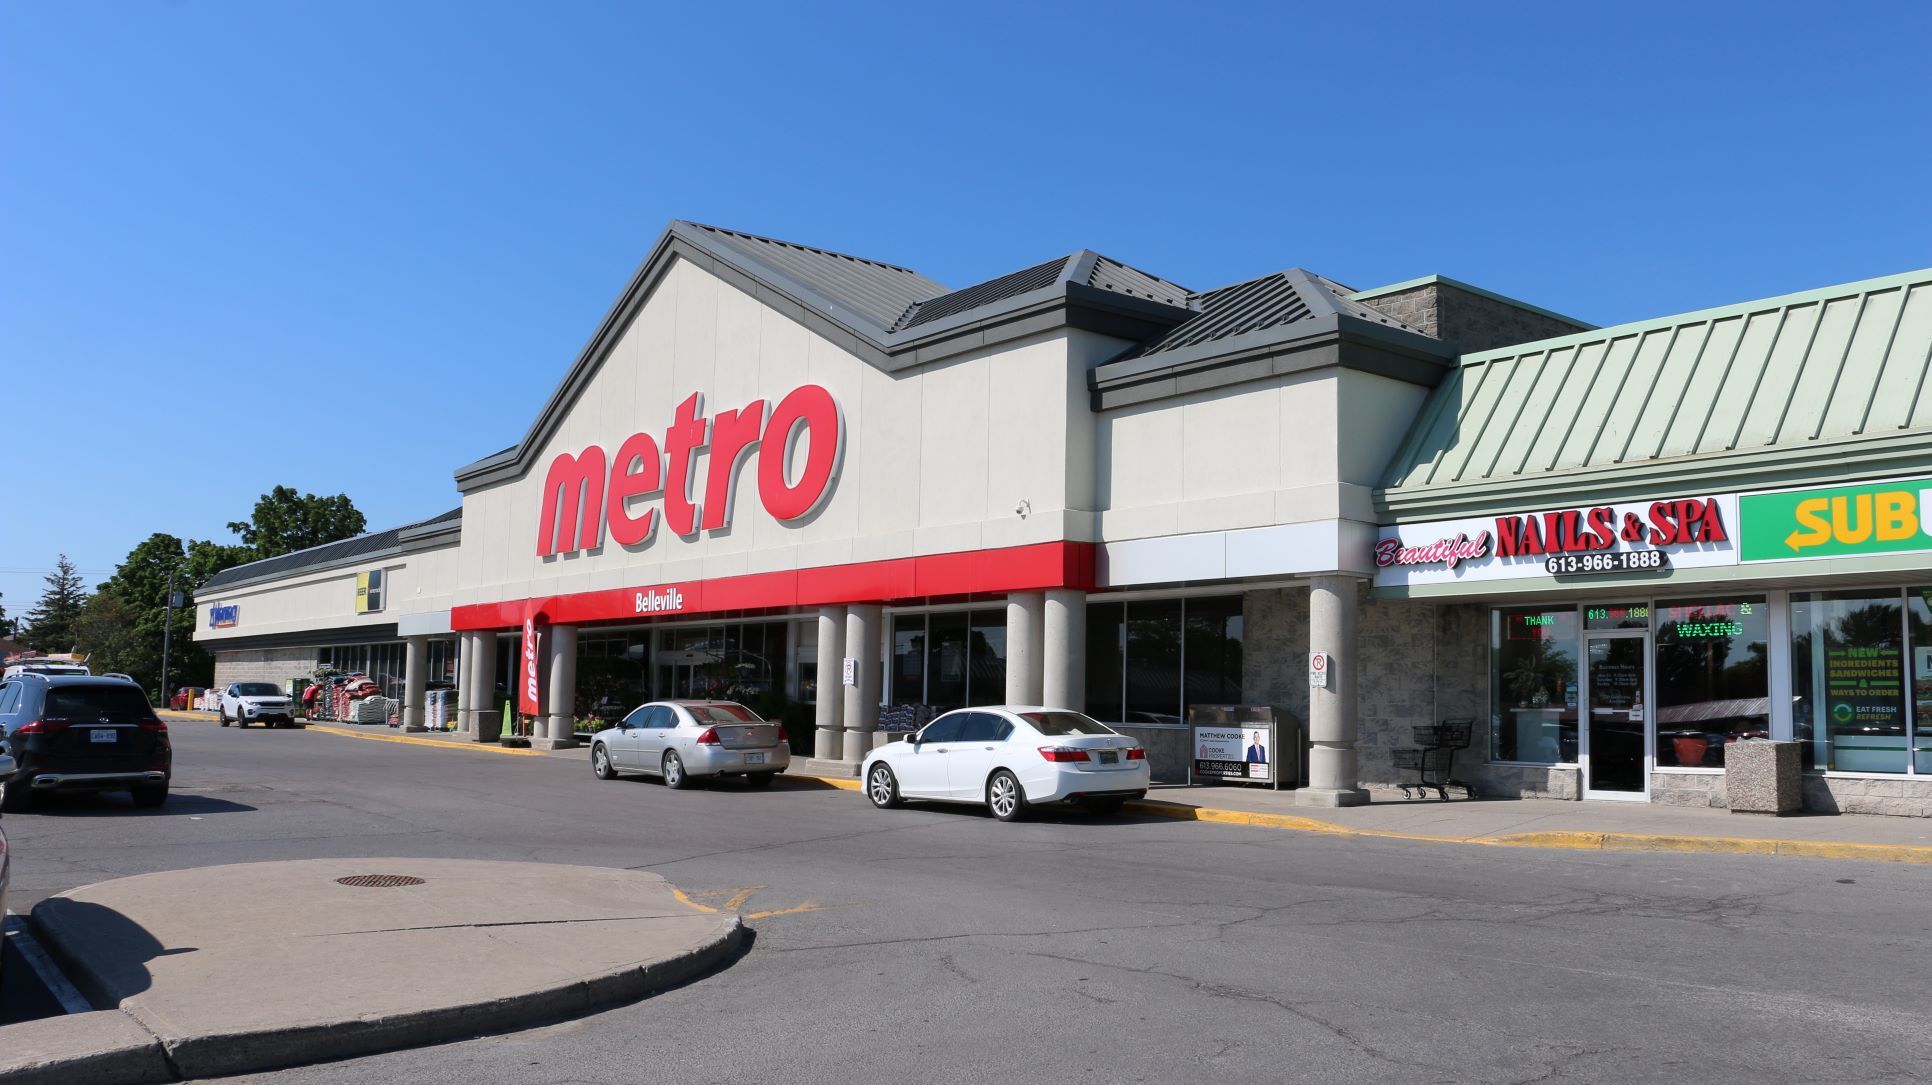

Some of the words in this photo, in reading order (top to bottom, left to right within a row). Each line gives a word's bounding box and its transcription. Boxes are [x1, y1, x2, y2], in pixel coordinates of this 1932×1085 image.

[537, 384, 844, 558] metro
[1784, 490, 1932, 553] SUB
[1375, 530, 1488, 569] Beautiful
[1495, 507, 1616, 558] NAILS
[1621, 512, 1644, 542] &
[1649, 498, 1728, 545] SPA
[1548, 551, 1661, 573] 613-966-1888
[635, 587, 683, 613] Belleville
[1740, 602, 1752, 615] &
[1524, 615, 1555, 626] THANK
[1677, 622, 1743, 637] WAXING
[525, 618, 537, 702] metro
[1848, 648, 1879, 657] NEW
[1830, 669, 1899, 677] SANDWICHES
[1200, 762, 1242, 771] 613.966.6060
